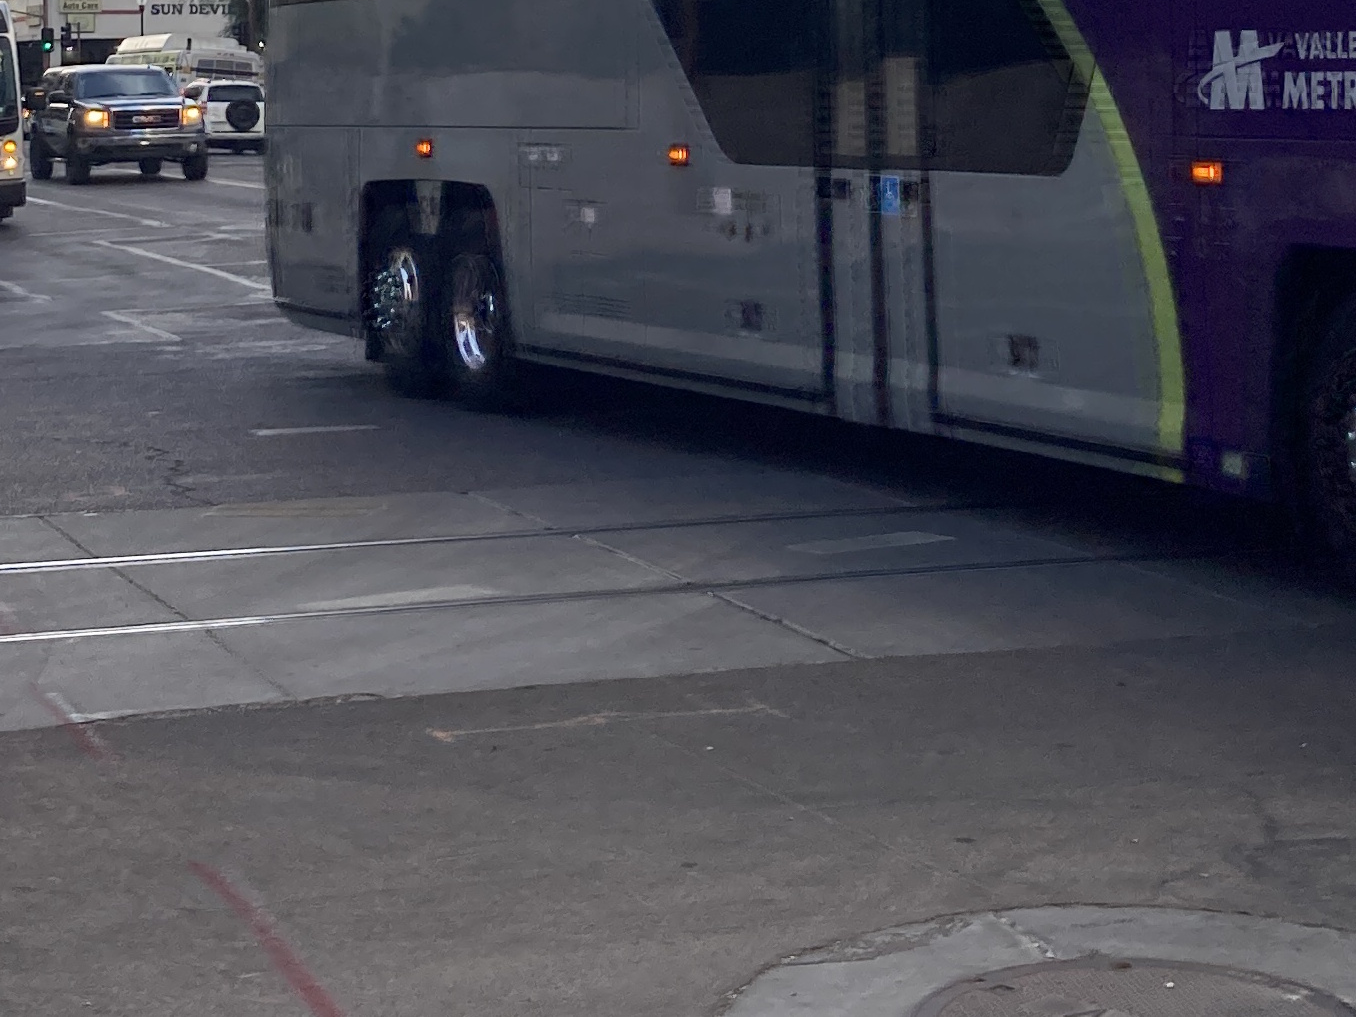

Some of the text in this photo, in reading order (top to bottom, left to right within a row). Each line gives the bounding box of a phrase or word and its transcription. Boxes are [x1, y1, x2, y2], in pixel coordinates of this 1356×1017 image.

[82, 2, 98, 10] Care
[151, 3, 233, 15] SUN DEVI
